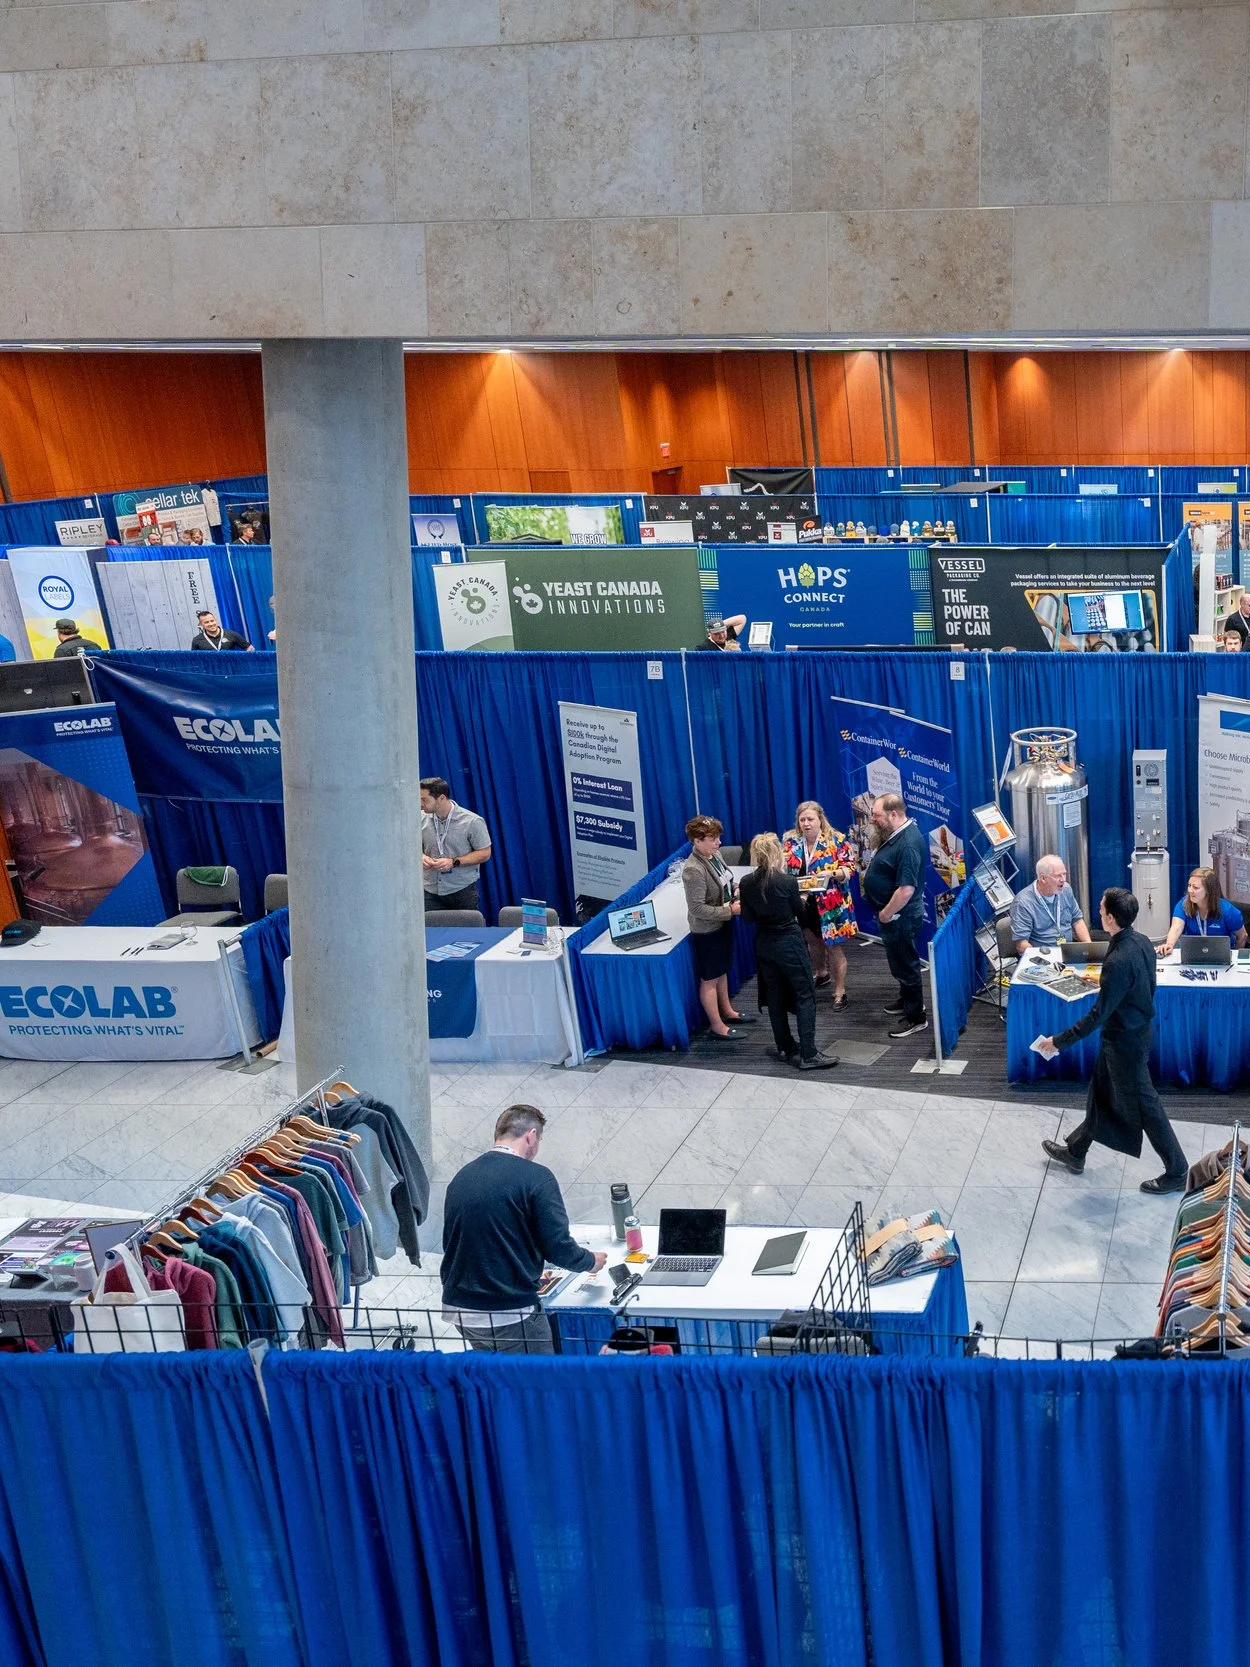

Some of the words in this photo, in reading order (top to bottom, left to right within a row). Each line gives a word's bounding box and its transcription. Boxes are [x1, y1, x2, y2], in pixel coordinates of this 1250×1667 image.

[181, 489, 200, 504] tek
[60, 524, 103, 536] RIPLEY
[798, 526, 822, 539] Pukka
[570, 533, 584, 544] WE
[584, 533, 608, 544] GROW
[939, 560, 982, 570] VESSEL
[188, 572, 200, 604] FREE
[448, 579, 465, 601] YEAST
[469, 577, 498, 596] CANADA
[542, 582, 592, 597] YEAST
[596, 580, 662, 596] CANADA
[784, 592, 845, 604] CONNECT
[942, 589, 968, 603] THE
[548, 599, 665, 614] INNOVATIONS
[944, 605, 990, 619] POWER
[946, 622, 961, 636] OF
[965, 622, 991, 636] CAN
[54, 717, 112, 732] ECOLAB
[173, 716, 280, 742] ECOLA
[566, 718, 588, 728] Receive
[567, 729, 584, 739] $100k
[585, 732, 608, 743] through
[609, 734, 618, 743] the
[852, 732, 896, 750] ContainerWor
[185, 743, 241, 754] PROTECTING
[568, 740, 596, 750] Canadian
[597, 744, 617, 754] Digital
[569, 750, 595, 760] Adoption
[596, 755, 622, 764] Program
[907, 750, 950, 772] ContainerWorld
[1204, 749, 1227, 760] Choose
[573, 776, 582, 785] 0%
[583, 778, 606, 789] Interest
[608, 783, 622, 792] Loan
[912, 772, 929, 784] From
[929, 777, 938, 788] the
[907, 781, 925, 794] World
[926, 787, 932, 796] to
[932, 791, 945, 802] your
[904, 791, 936, 809] Customers'
[936, 804, 950, 816] Door
[576, 815, 597, 826] $7,300
[598, 820, 623, 832] Subsidy
[9, 1025, 92, 1036] PROTECTING
[94, 1025, 143, 1036] WHAT'S
